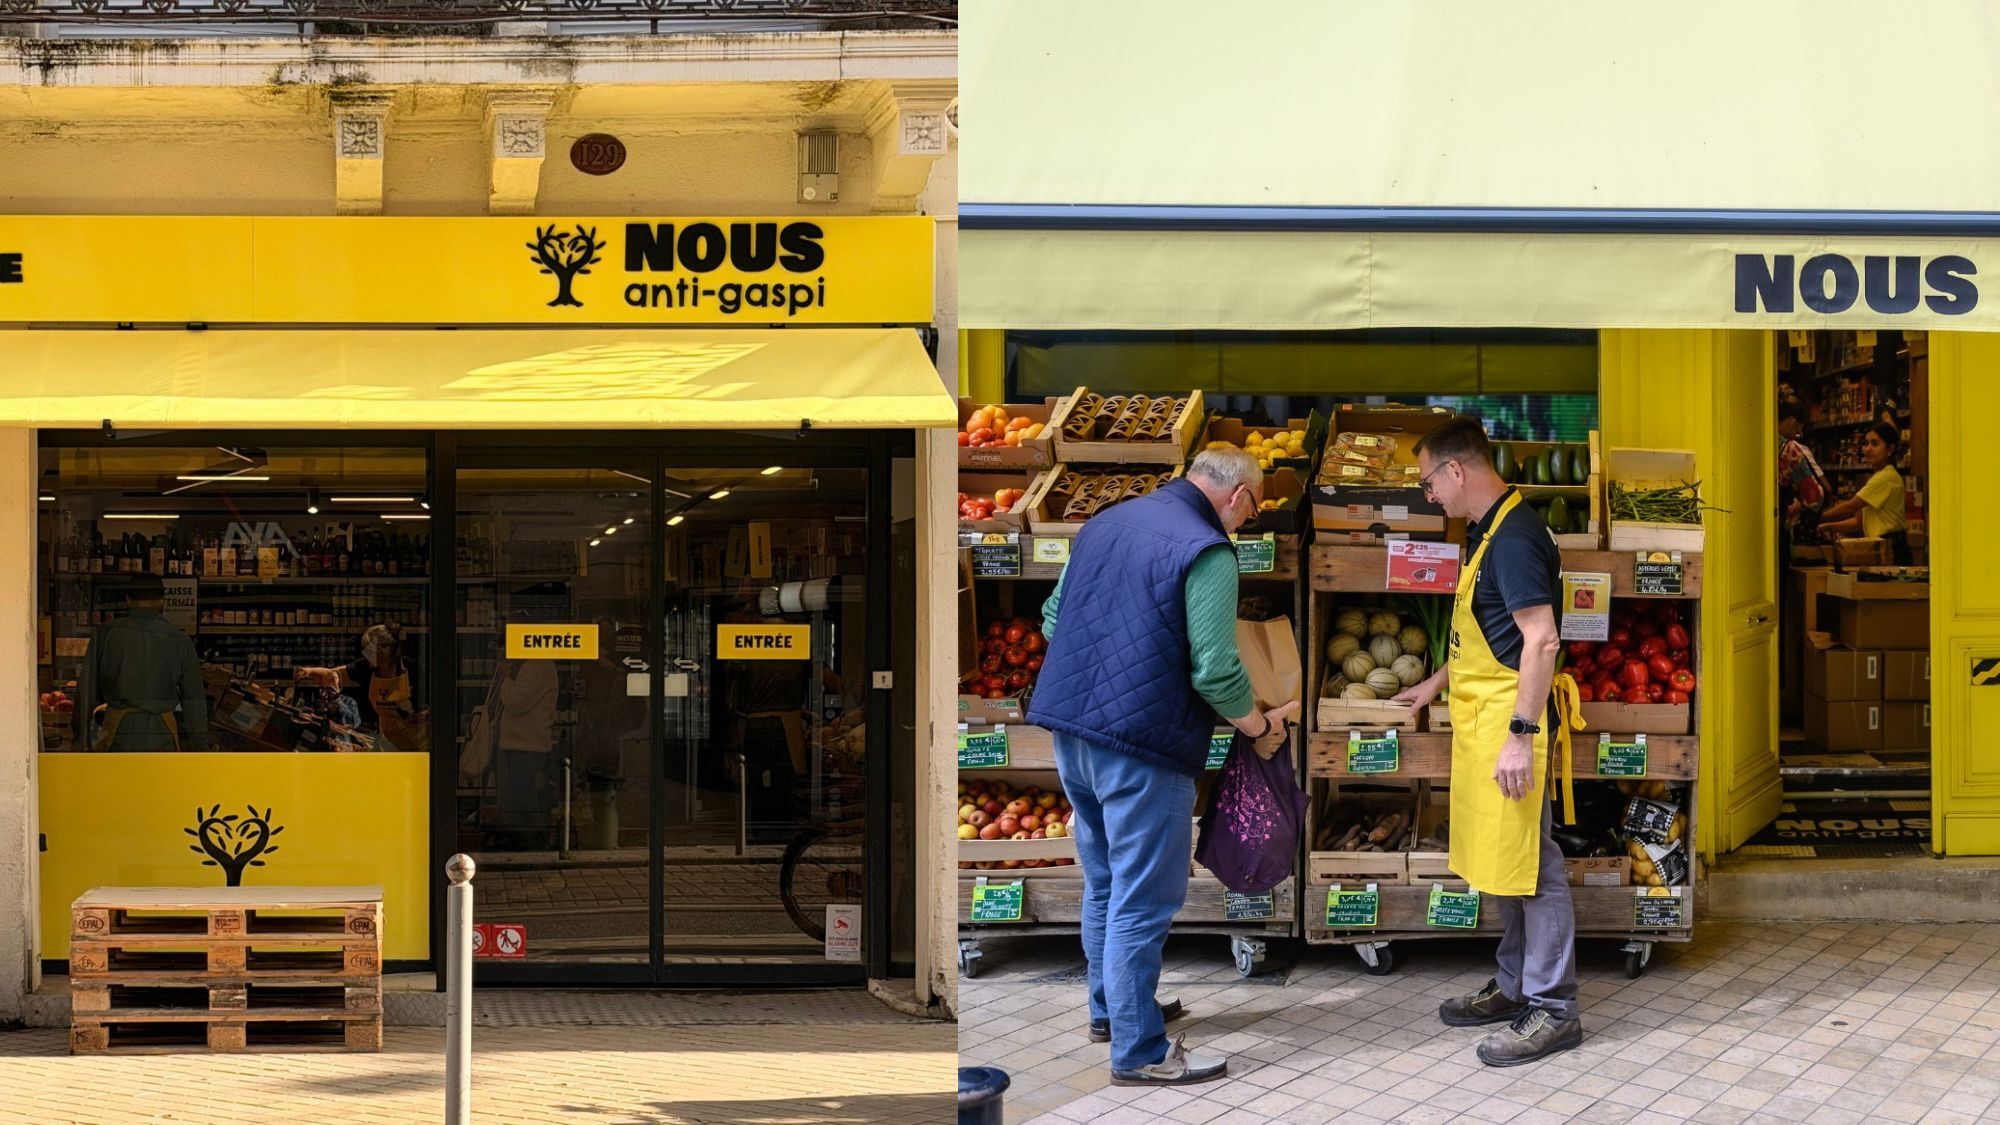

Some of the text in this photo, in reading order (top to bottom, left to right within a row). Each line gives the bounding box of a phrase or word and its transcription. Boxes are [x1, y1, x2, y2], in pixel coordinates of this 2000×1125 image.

[581, 143, 619, 167] 129
[625, 222, 825, 272] NOUS
[1735, 254, 1979, 315] NOUS
[625, 277, 825, 316] anti-gaspi
[523, 632, 581, 648] ENTRÉE
[735, 632, 792, 648] ENTRÉE
[1775, 818, 1931, 831] NOUS
[1777, 830, 1931, 839] anti-gasp
